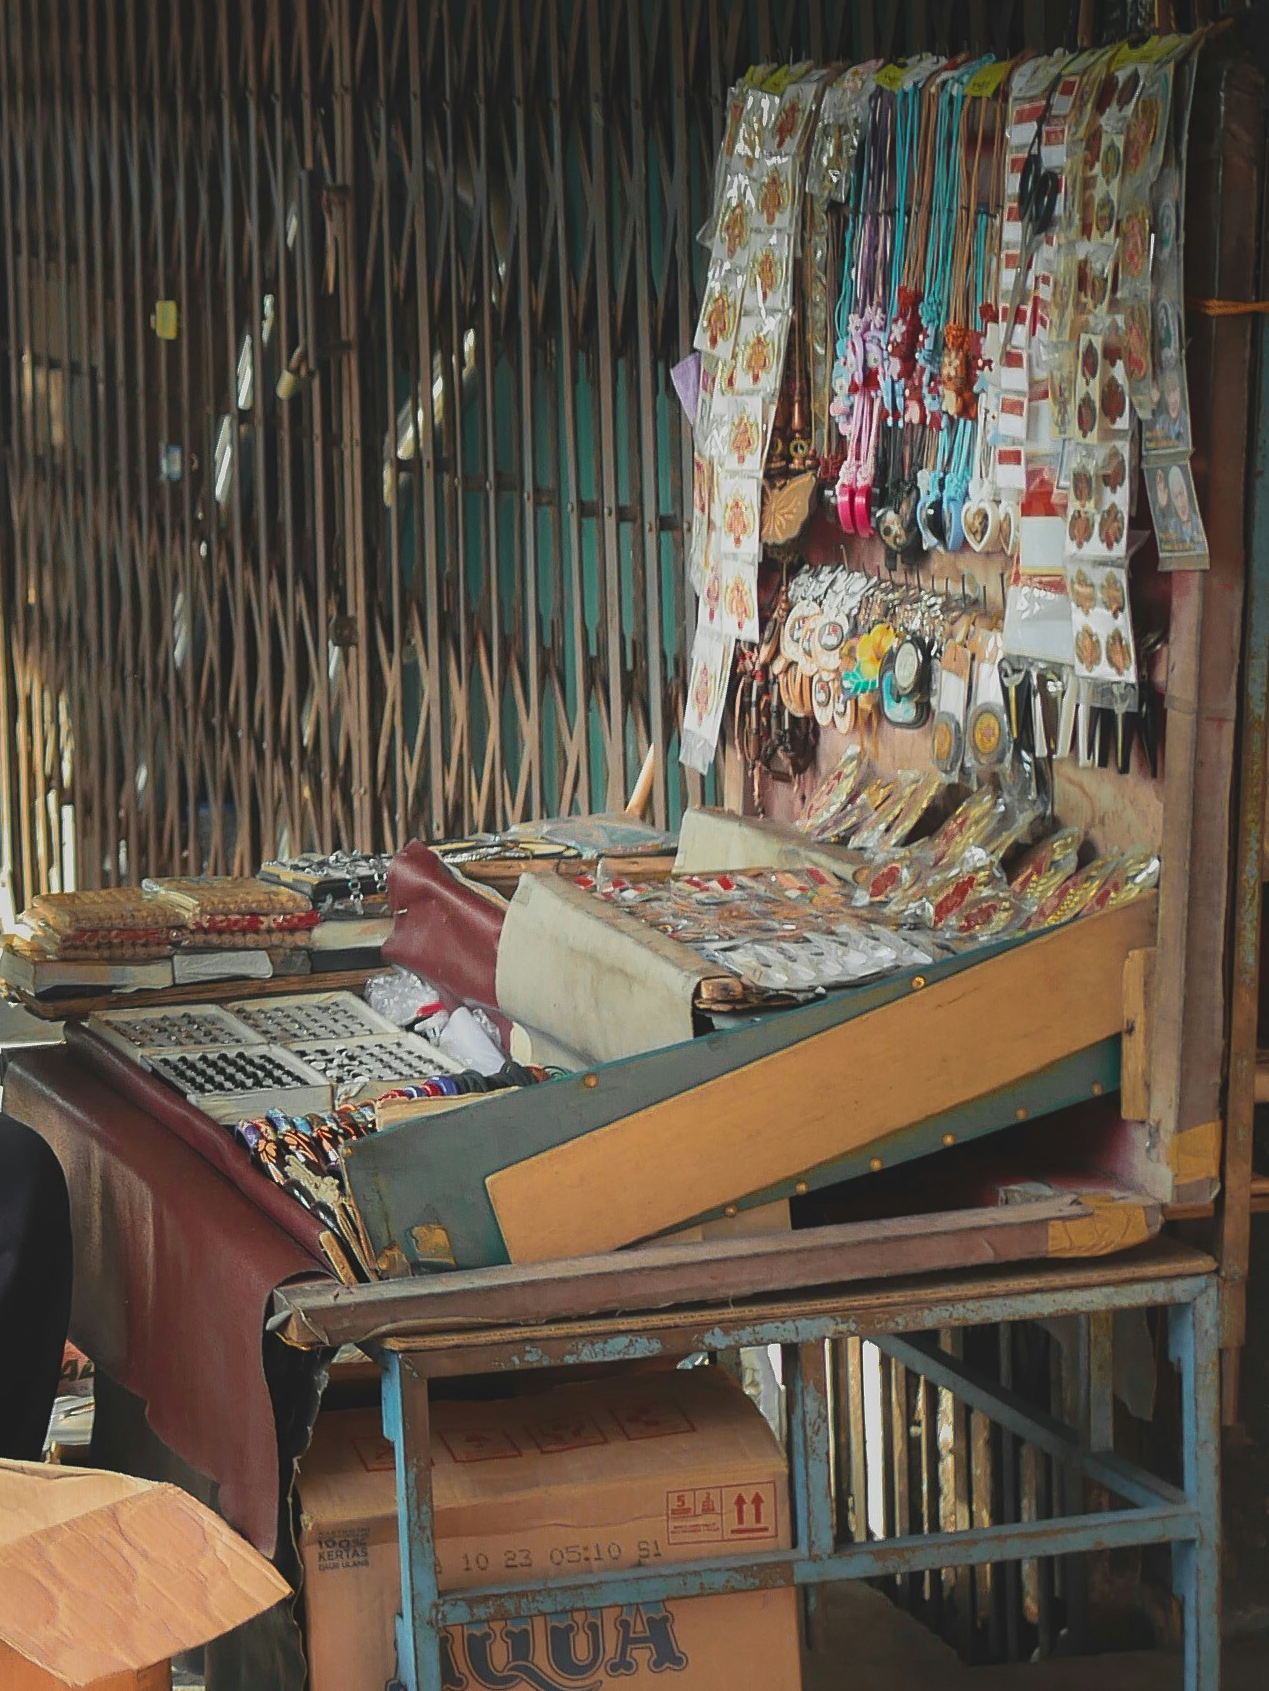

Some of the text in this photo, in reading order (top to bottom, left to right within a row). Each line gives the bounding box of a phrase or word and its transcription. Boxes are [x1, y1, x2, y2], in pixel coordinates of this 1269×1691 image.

[318, 1548, 369, 1562] KERTAS
[462, 1552, 489, 1571] 10
[503, 1549, 533, 1569] 23
[549, 1542, 622, 1566] 05:10
